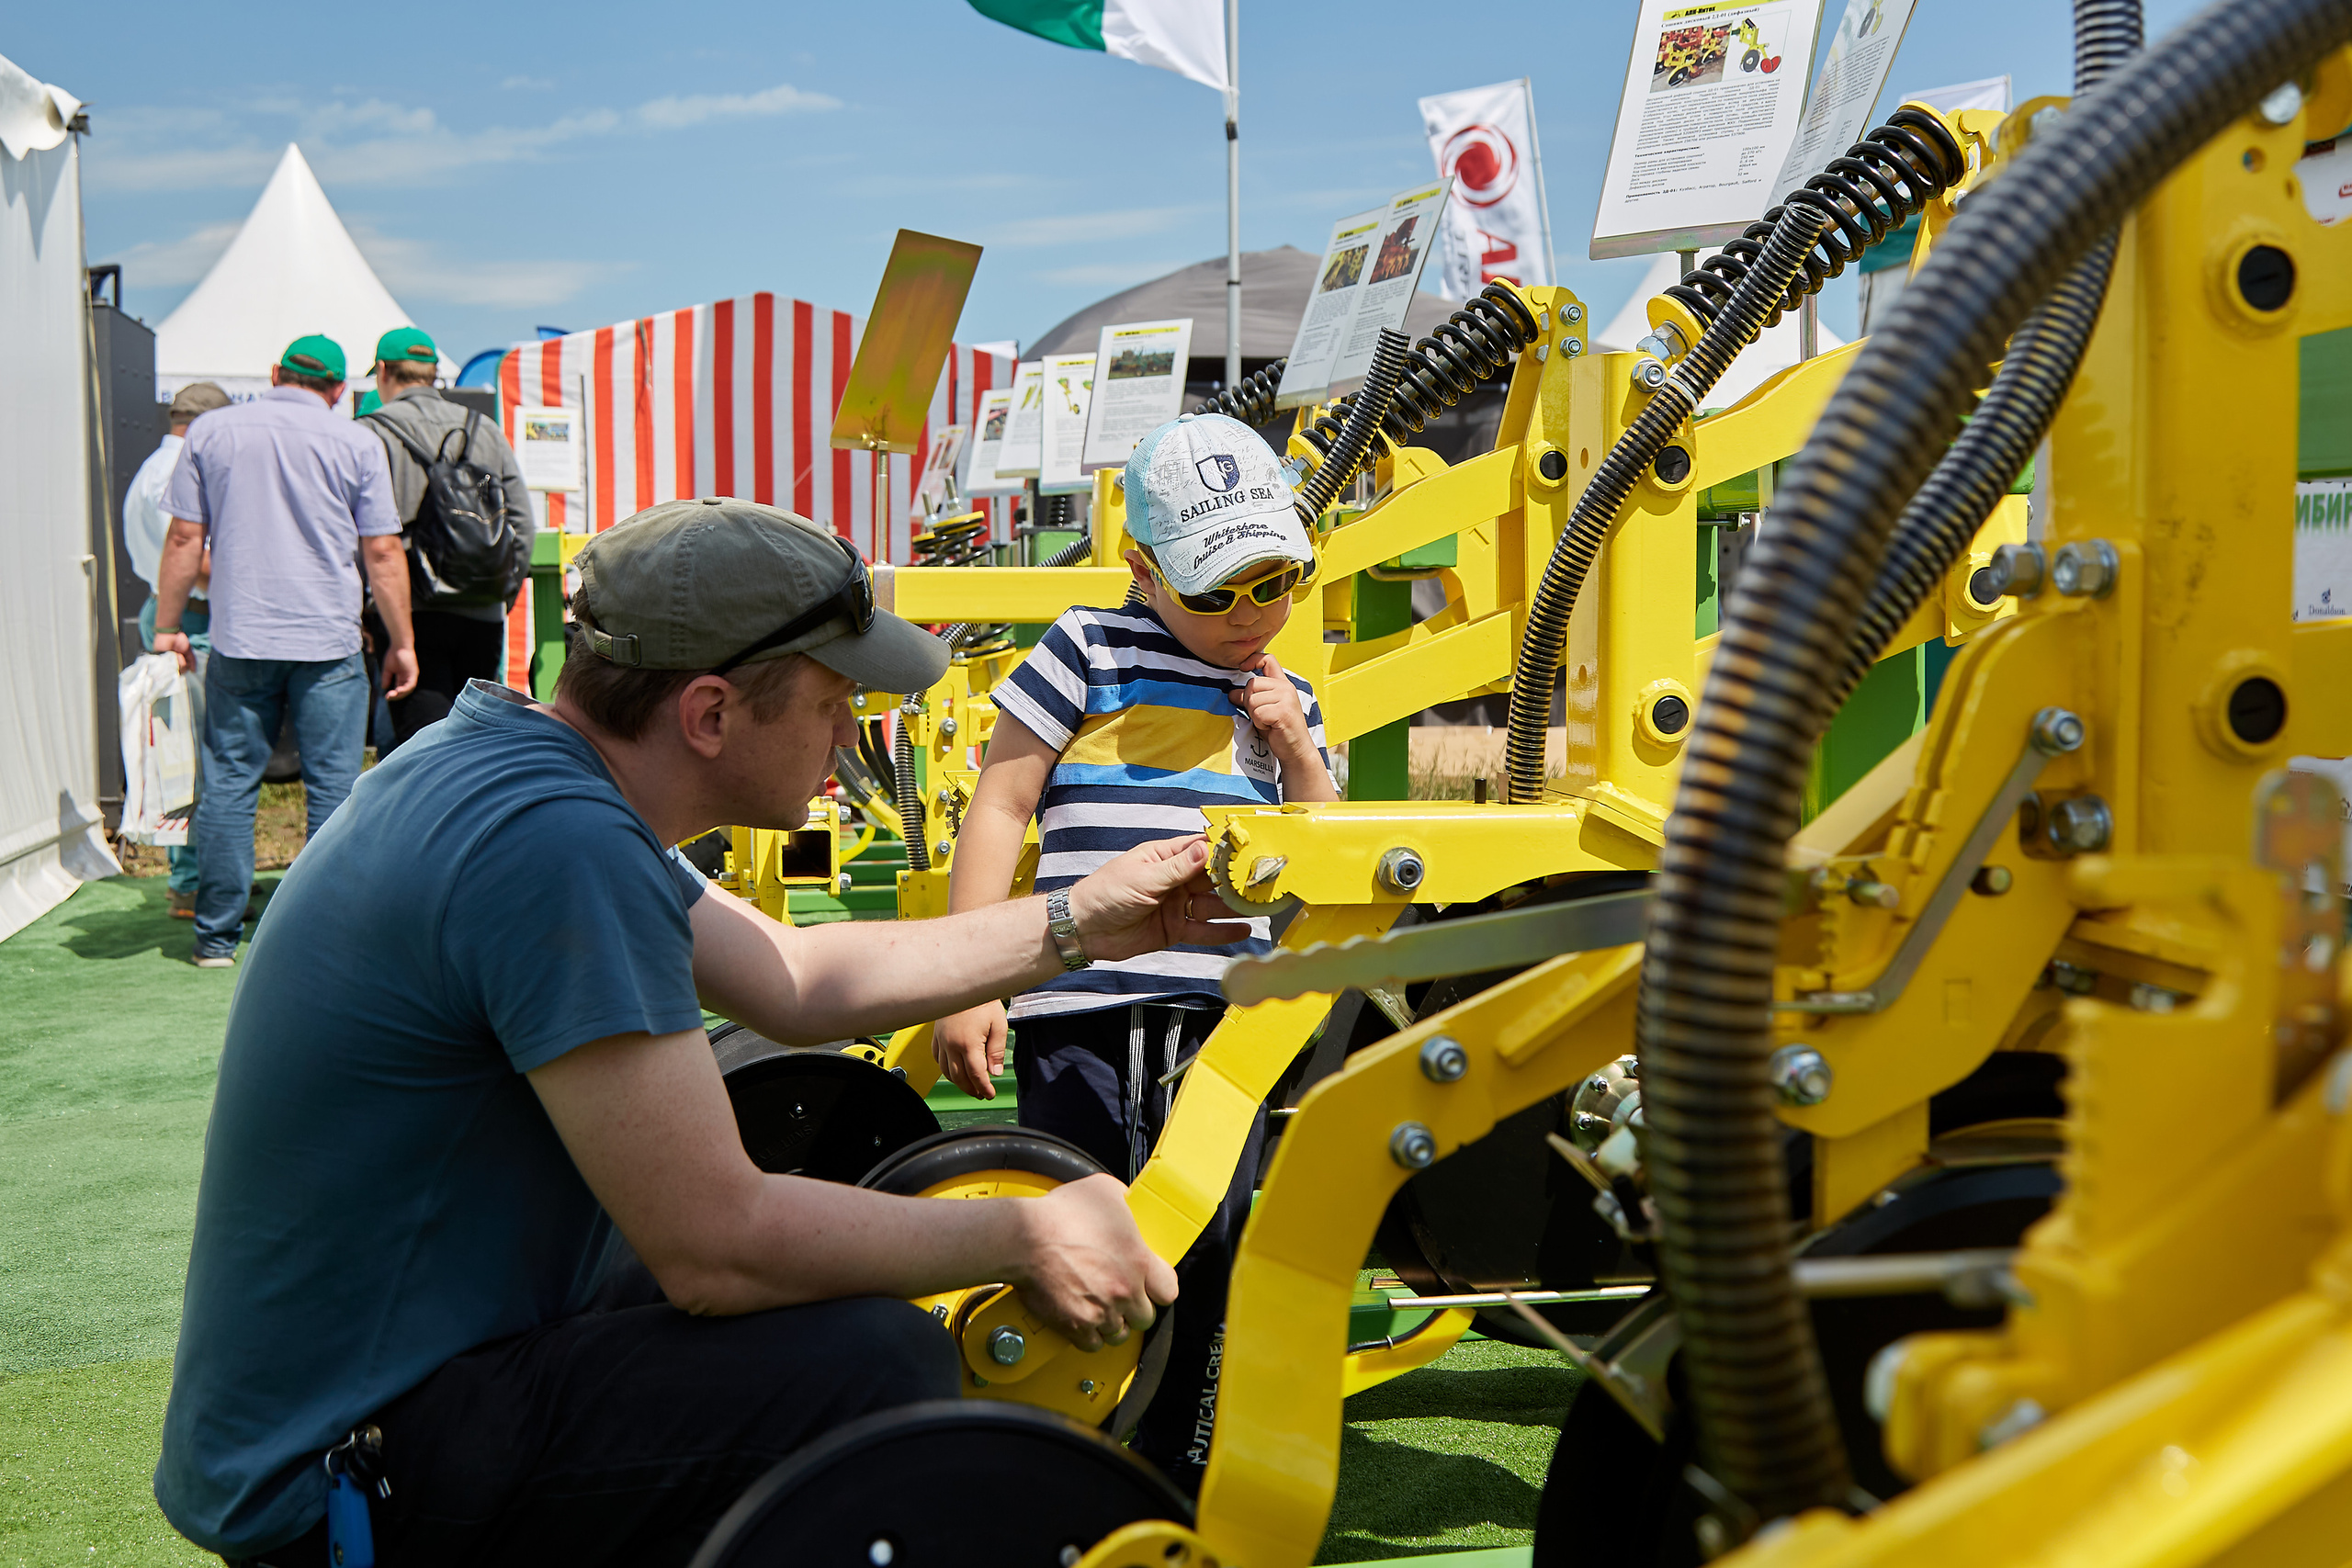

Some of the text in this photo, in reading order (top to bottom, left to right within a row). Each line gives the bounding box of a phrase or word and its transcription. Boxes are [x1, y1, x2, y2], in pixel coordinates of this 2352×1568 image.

[1180, 487, 1274, 523] SAILING SEA
[1194, 530, 1288, 569] Cruise & Shipping
[1203, 522, 1268, 548] Whiteshore
[1245, 757, 1274, 773] MARSEILLE
